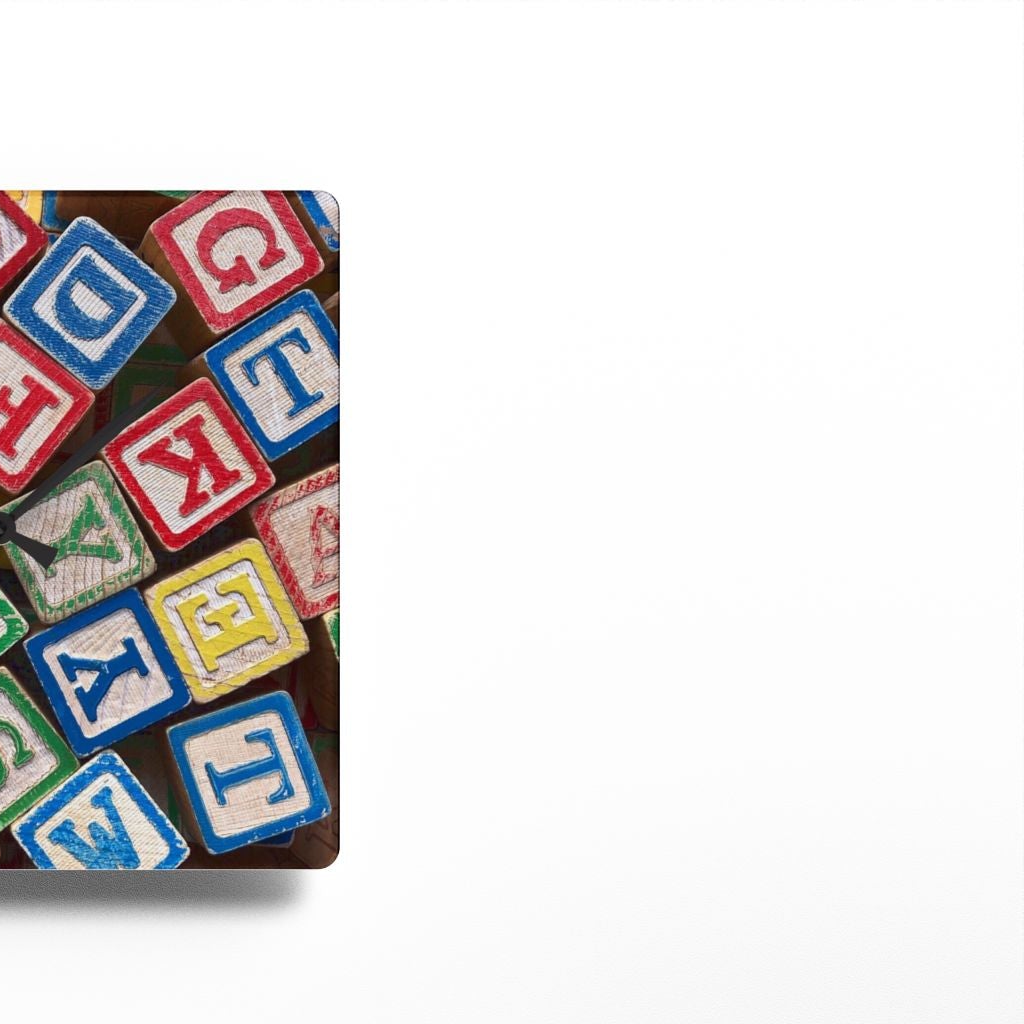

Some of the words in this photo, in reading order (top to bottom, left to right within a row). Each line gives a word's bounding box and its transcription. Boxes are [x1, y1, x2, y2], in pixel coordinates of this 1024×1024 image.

[196, 207, 286, 294] G
[55, 253, 138, 341] D
[240, 327, 324, 417] T
[137, 413, 243, 517] K
[45, 493, 124, 579] A
[176, 573, 278, 672] E
[57, 636, 149, 722] Y
[205, 728, 295, 806] T
